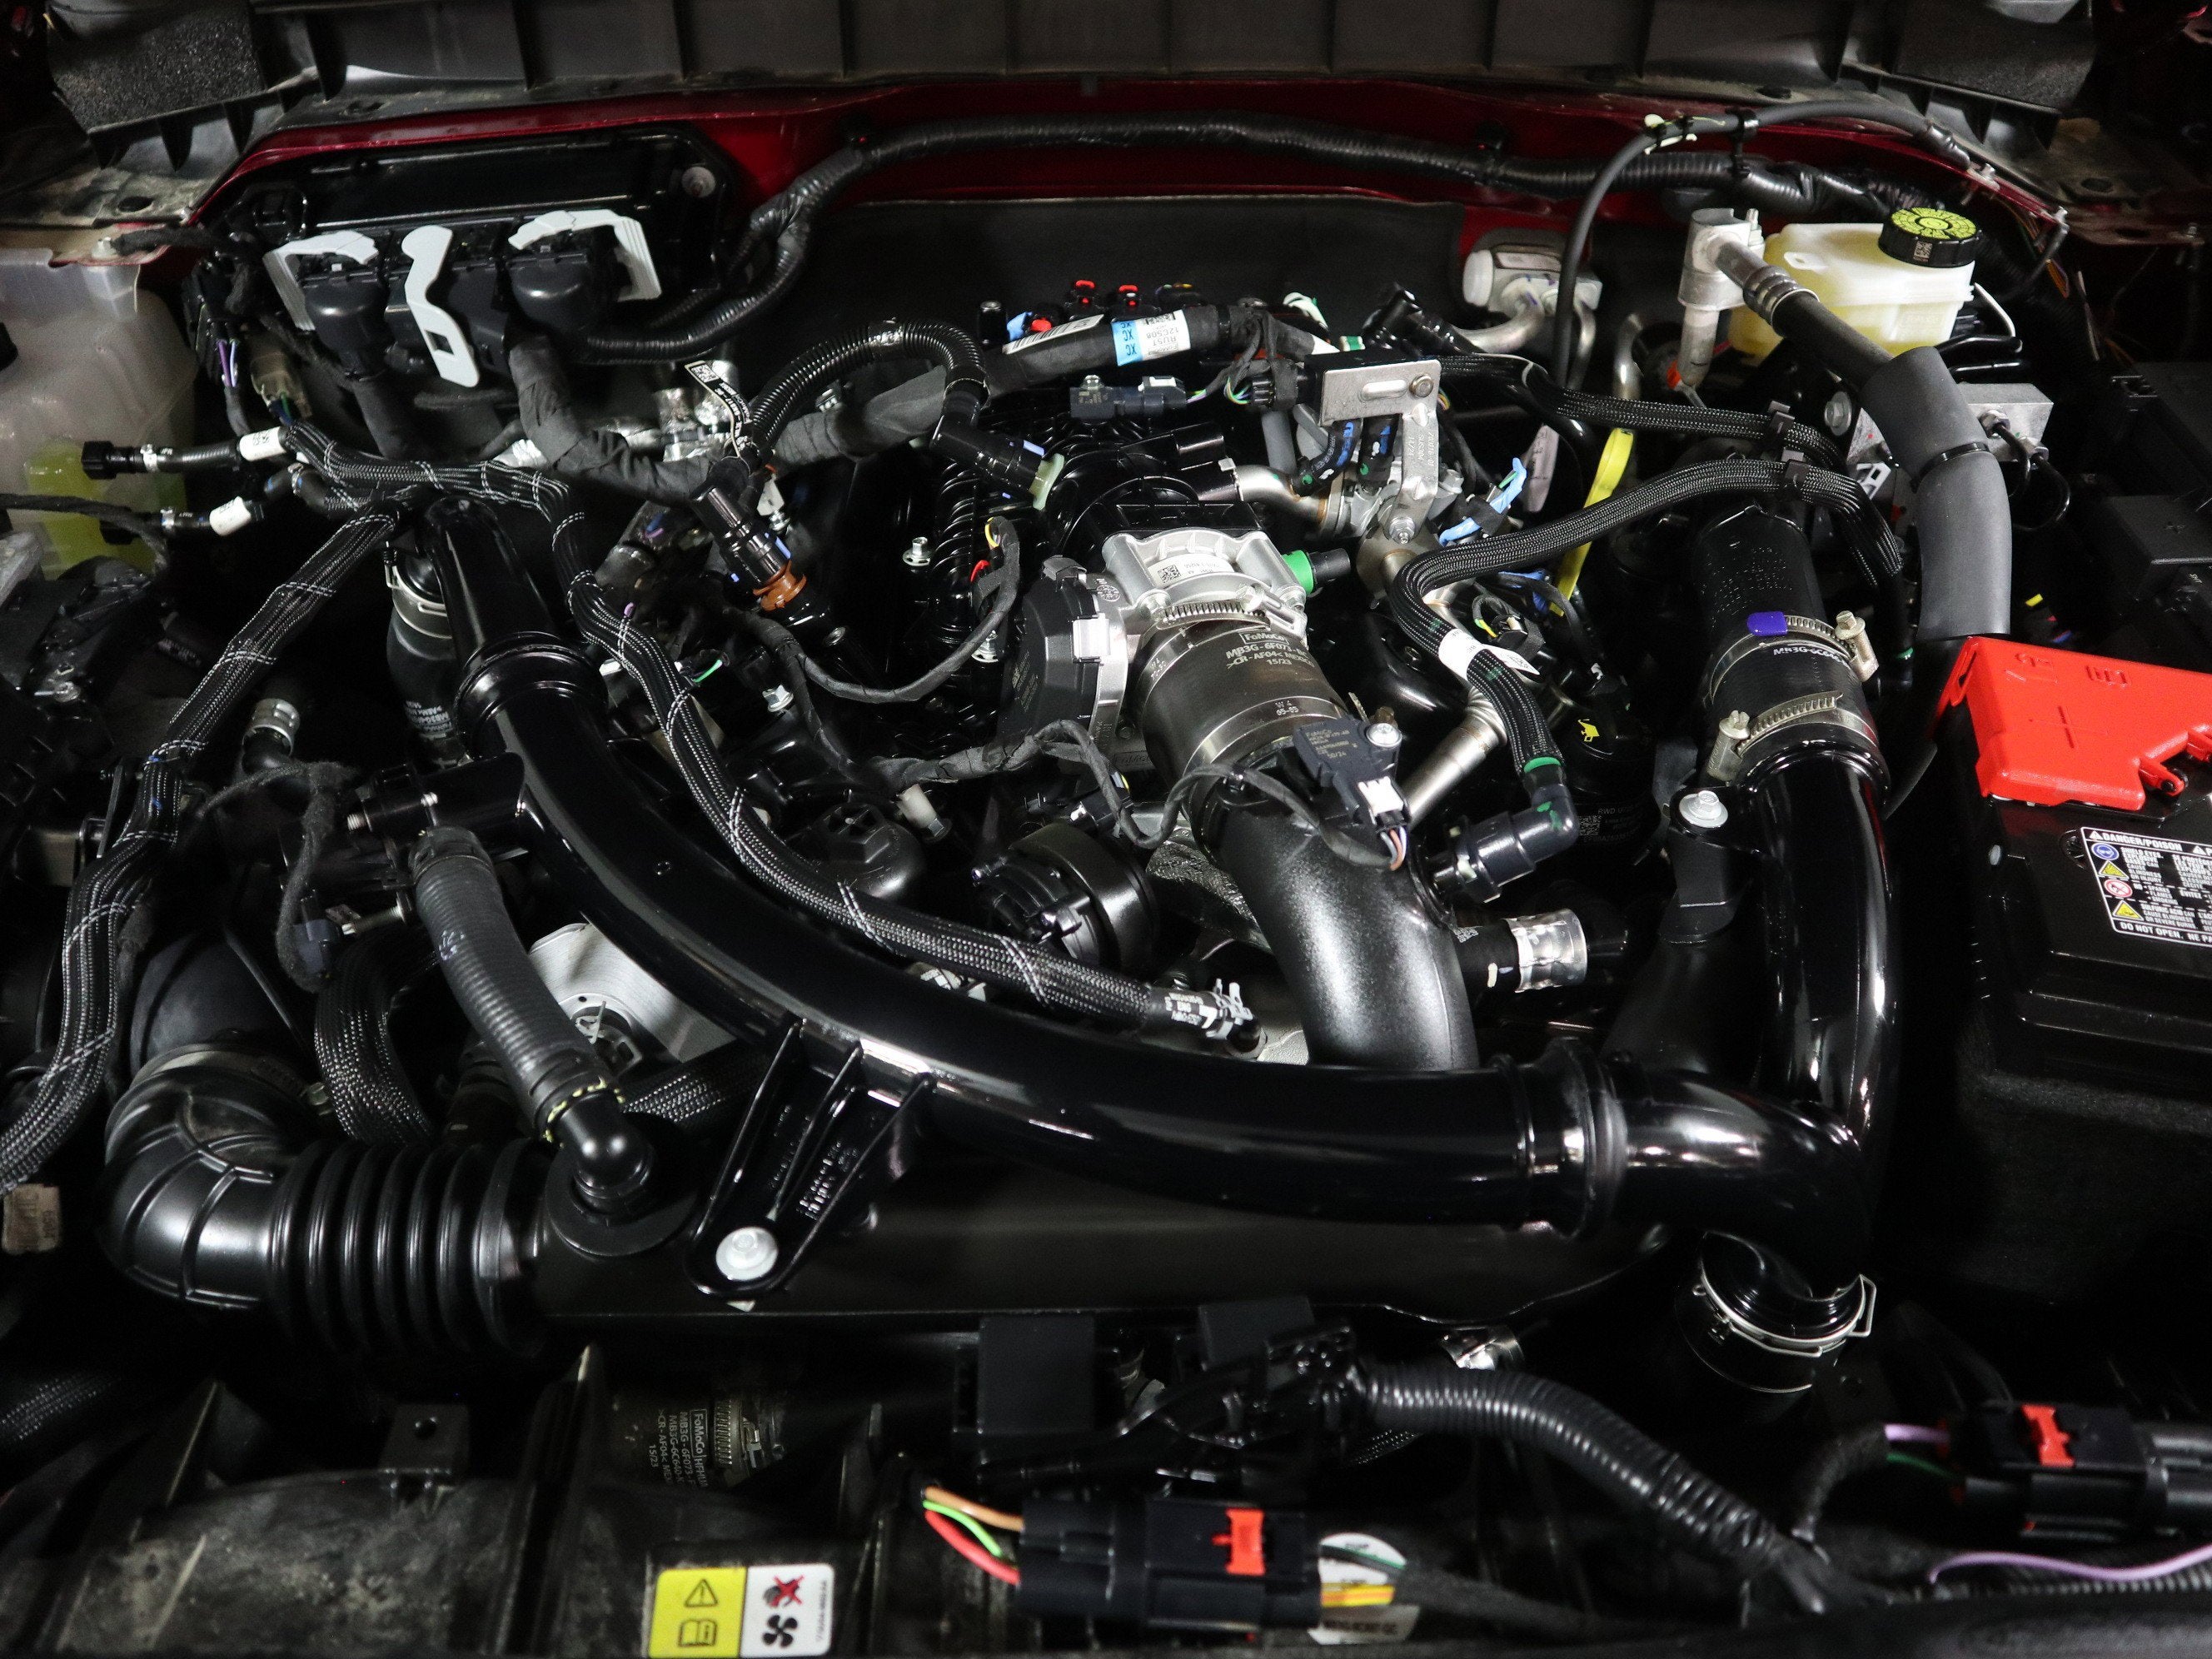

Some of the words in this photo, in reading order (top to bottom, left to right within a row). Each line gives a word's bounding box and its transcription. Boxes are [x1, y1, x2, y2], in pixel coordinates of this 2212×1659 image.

[1122, 329, 1133, 341] XC
[1125, 342, 1137, 356] XC
[1244, 632, 1286, 641] FoMoCo
[2101, 832, 2182, 850] DANGER/POISON
[2120, 847, 2145, 855] SHIELD
[2122, 853, 2158, 862] EXPLOSIVE
[2127, 868, 2162, 877] BLINDNESS
[2151, 896, 2179, 904] SMOKING
[2140, 904, 2170, 913] SULFURIC
[2161, 913, 2194, 922] BLINDNESS
[2119, 922, 2135, 930] DO
[2135, 924, 2155, 934] NOT
[2155, 928, 2184, 939] OPEN.
[694, 1412, 705, 1455] FoMoCo
[649, 1444, 659, 1468] 15/23
